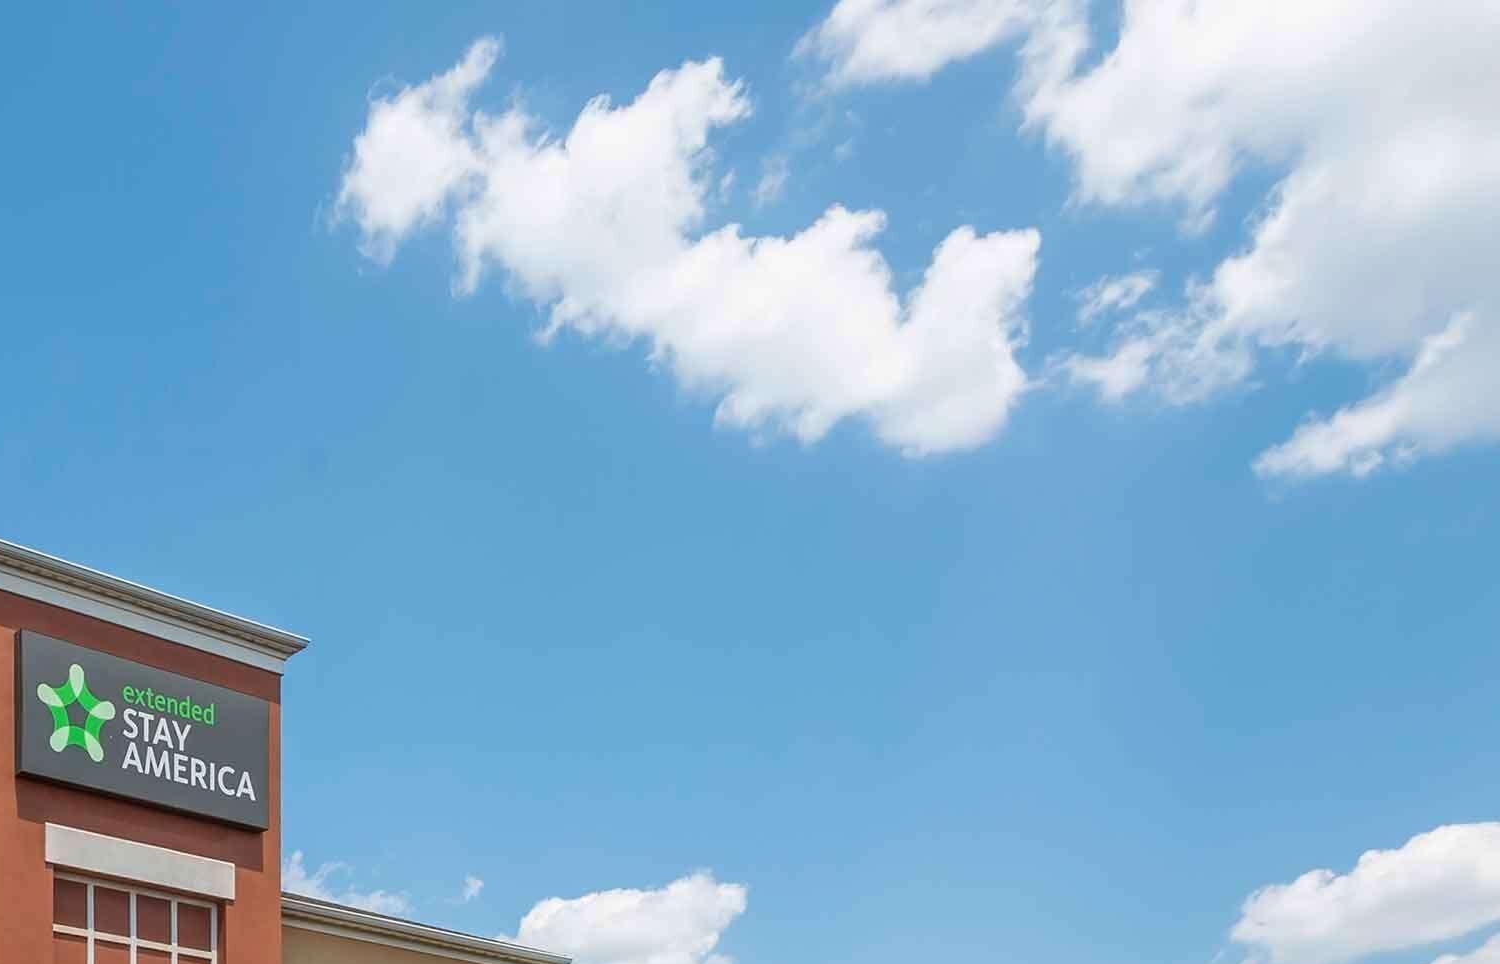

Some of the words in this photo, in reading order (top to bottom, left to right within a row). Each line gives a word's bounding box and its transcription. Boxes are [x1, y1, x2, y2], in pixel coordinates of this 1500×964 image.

[123, 686, 215, 725] extended
[123, 708, 192, 750] STAY
[122, 743, 256, 801] AMERICA
